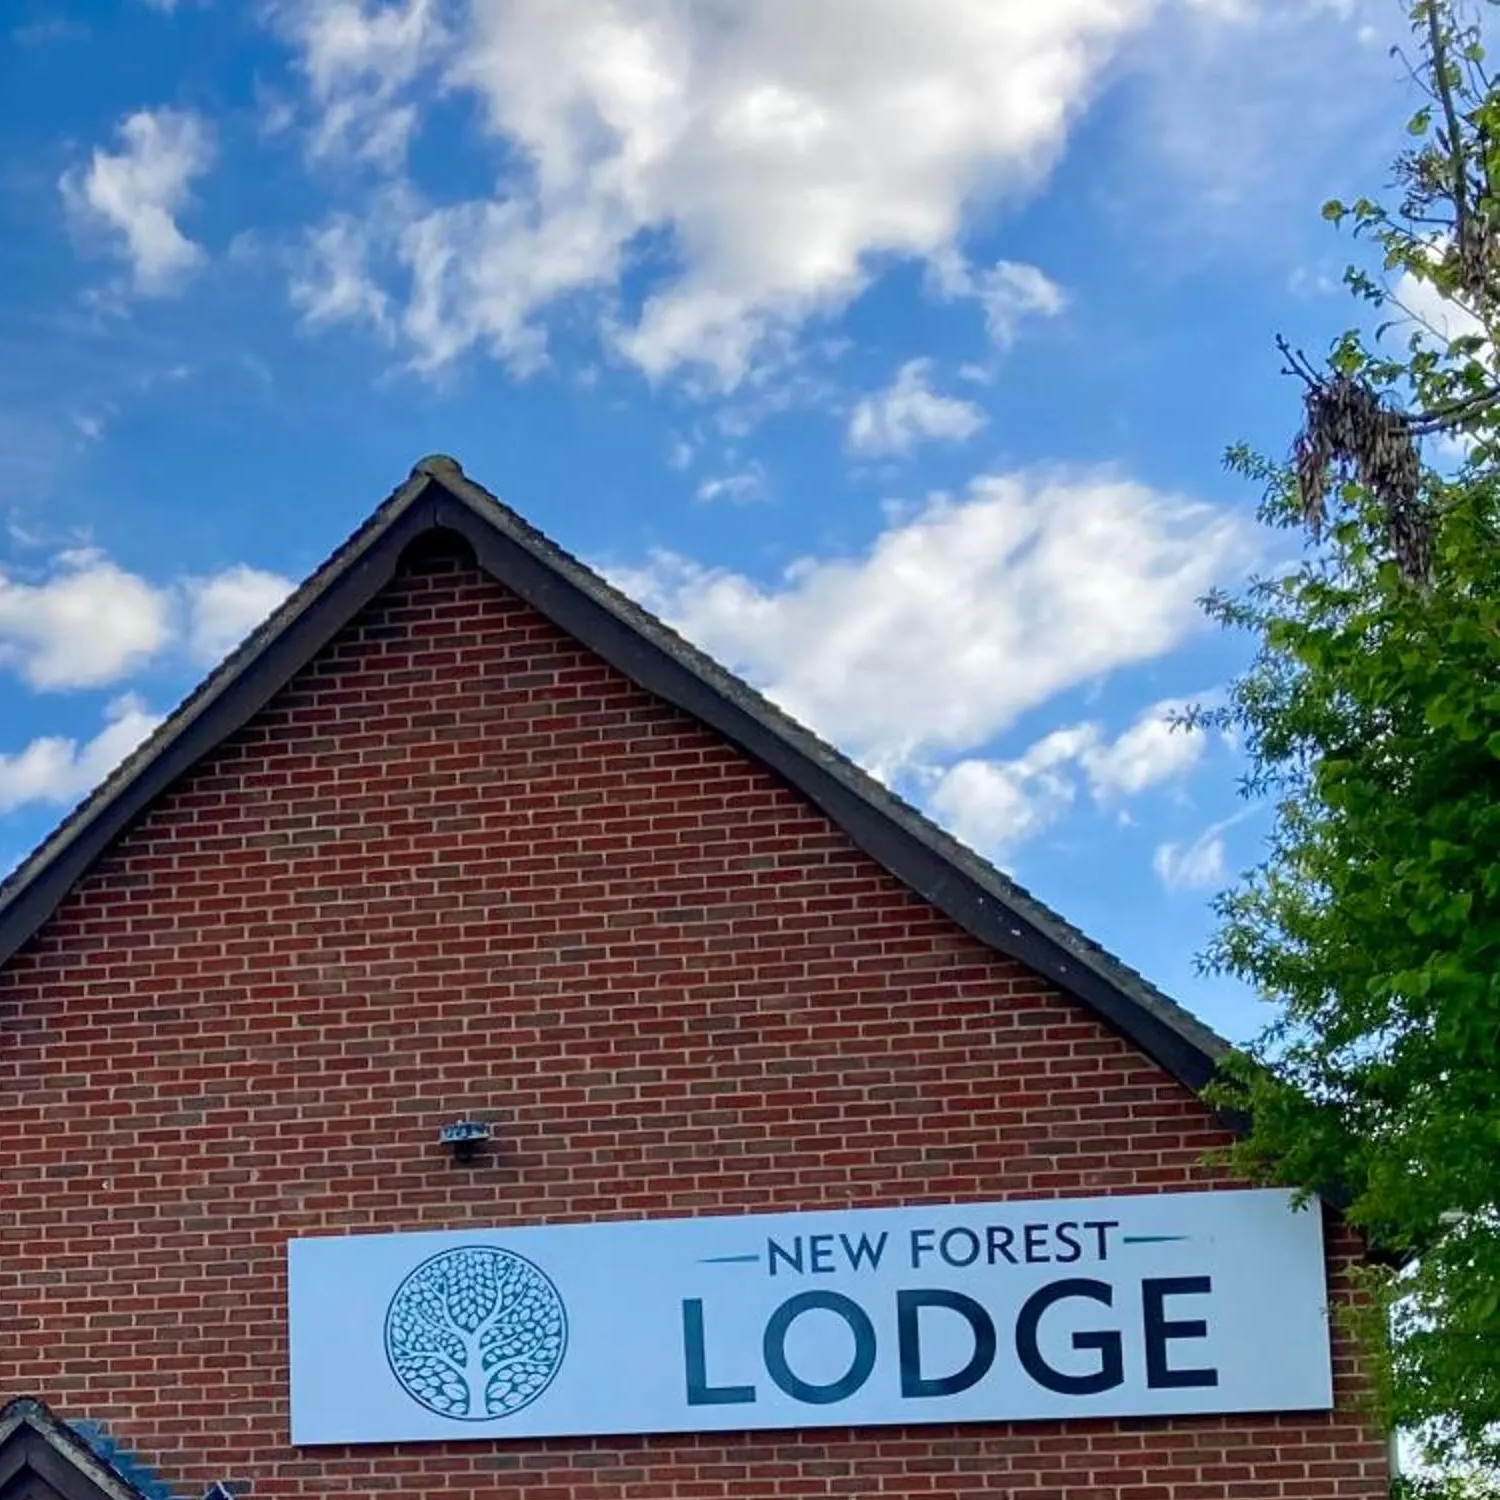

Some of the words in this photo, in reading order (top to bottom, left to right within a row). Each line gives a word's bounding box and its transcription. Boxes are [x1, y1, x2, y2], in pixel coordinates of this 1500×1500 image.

[766, 1230, 890, 1278] NEW
[909, 1219, 1121, 1270] FOREST
[681, 1274, 1220, 1407] LODGE
